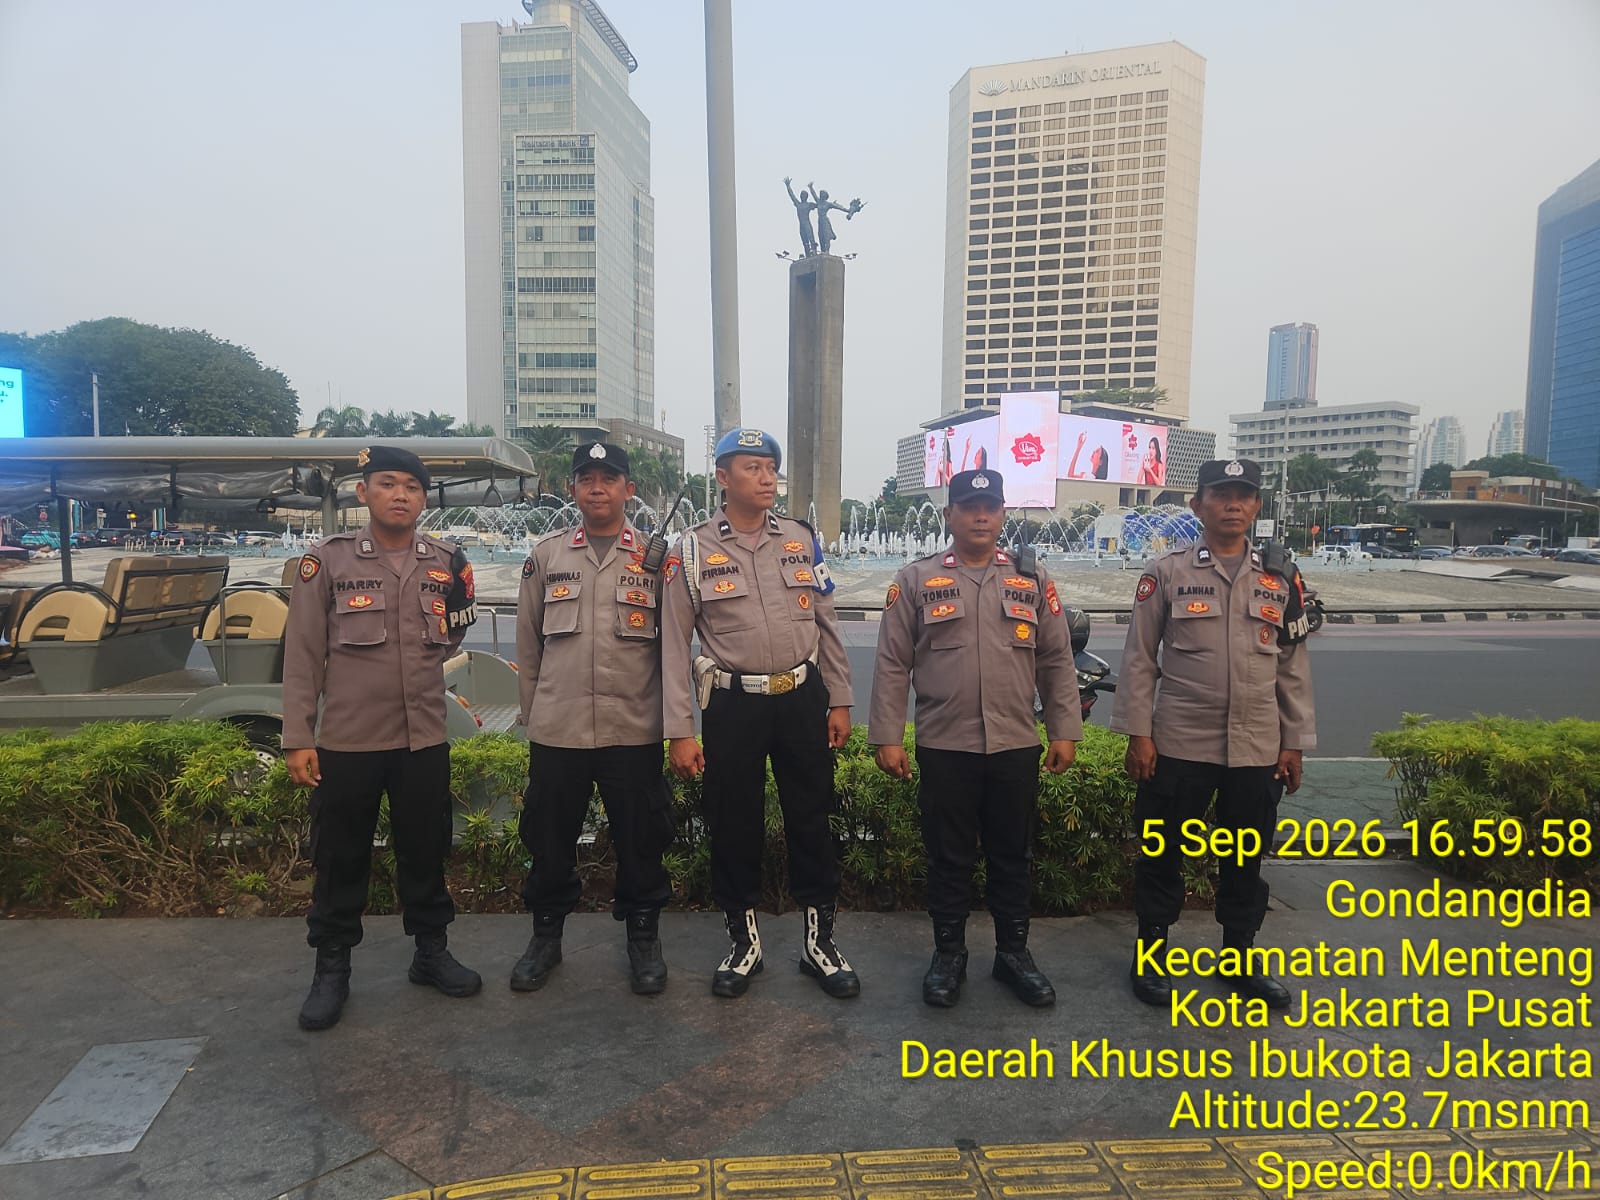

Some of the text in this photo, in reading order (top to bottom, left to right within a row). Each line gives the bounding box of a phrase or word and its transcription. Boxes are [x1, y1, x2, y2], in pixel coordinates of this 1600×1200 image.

[1010, 60, 1162, 92] MANDARIN ORIENTAL
[780, 554, 811, 567] POLRI
[701, 565, 739, 581] FIRMAN
[336, 579, 383, 591] HARRY
[620, 575, 654, 589] POLRI
[922, 587, 960, 603] YONGKI
[1004, 589, 1035, 605] POLRI
[1254, 589, 1286, 605] POLRI
